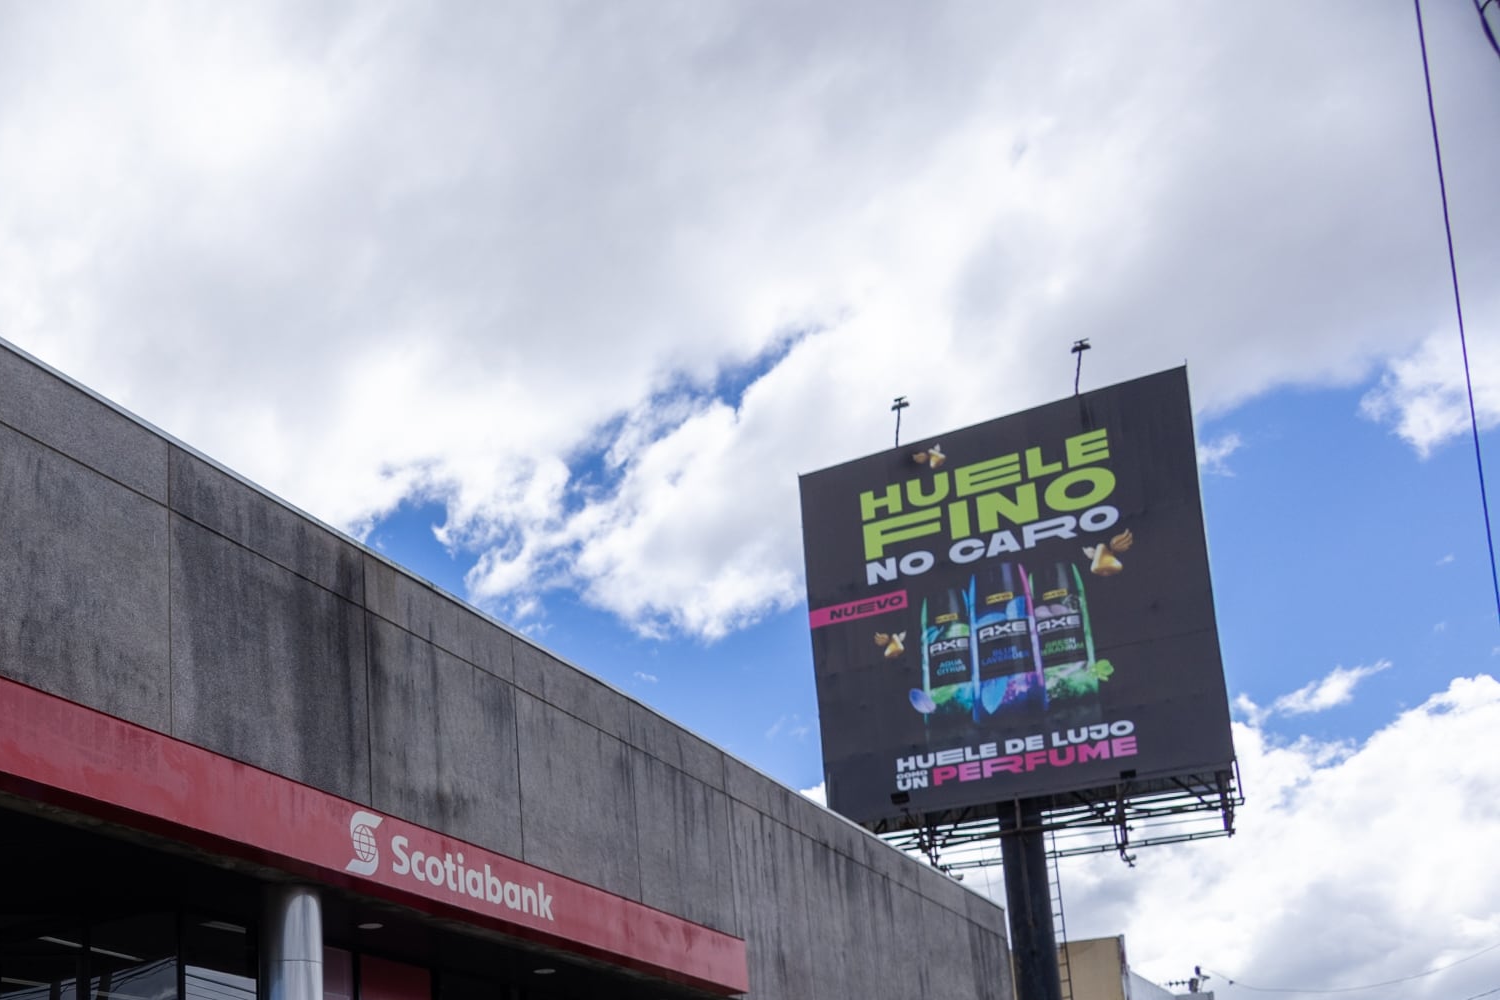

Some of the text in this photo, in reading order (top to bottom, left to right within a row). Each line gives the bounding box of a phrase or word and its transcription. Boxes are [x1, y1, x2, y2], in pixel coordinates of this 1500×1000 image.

[860, 428, 1110, 521] HUELE
[862, 466, 1116, 561] FINO
[865, 505, 1120, 586] NO CARO
[829, 595, 903, 620] NUEVO
[1037, 614, 1081, 633] AXE
[929, 638, 969, 655] AXE
[980, 621, 1027, 640] AXE
[936, 663, 967, 676] CITRUS
[896, 720, 1134, 772] HUELE DE LUJO
[896, 735, 1138, 792] UN PERFUME
[896, 769, 928, 781] COMO
[391, 835, 554, 921] Scotiabank
